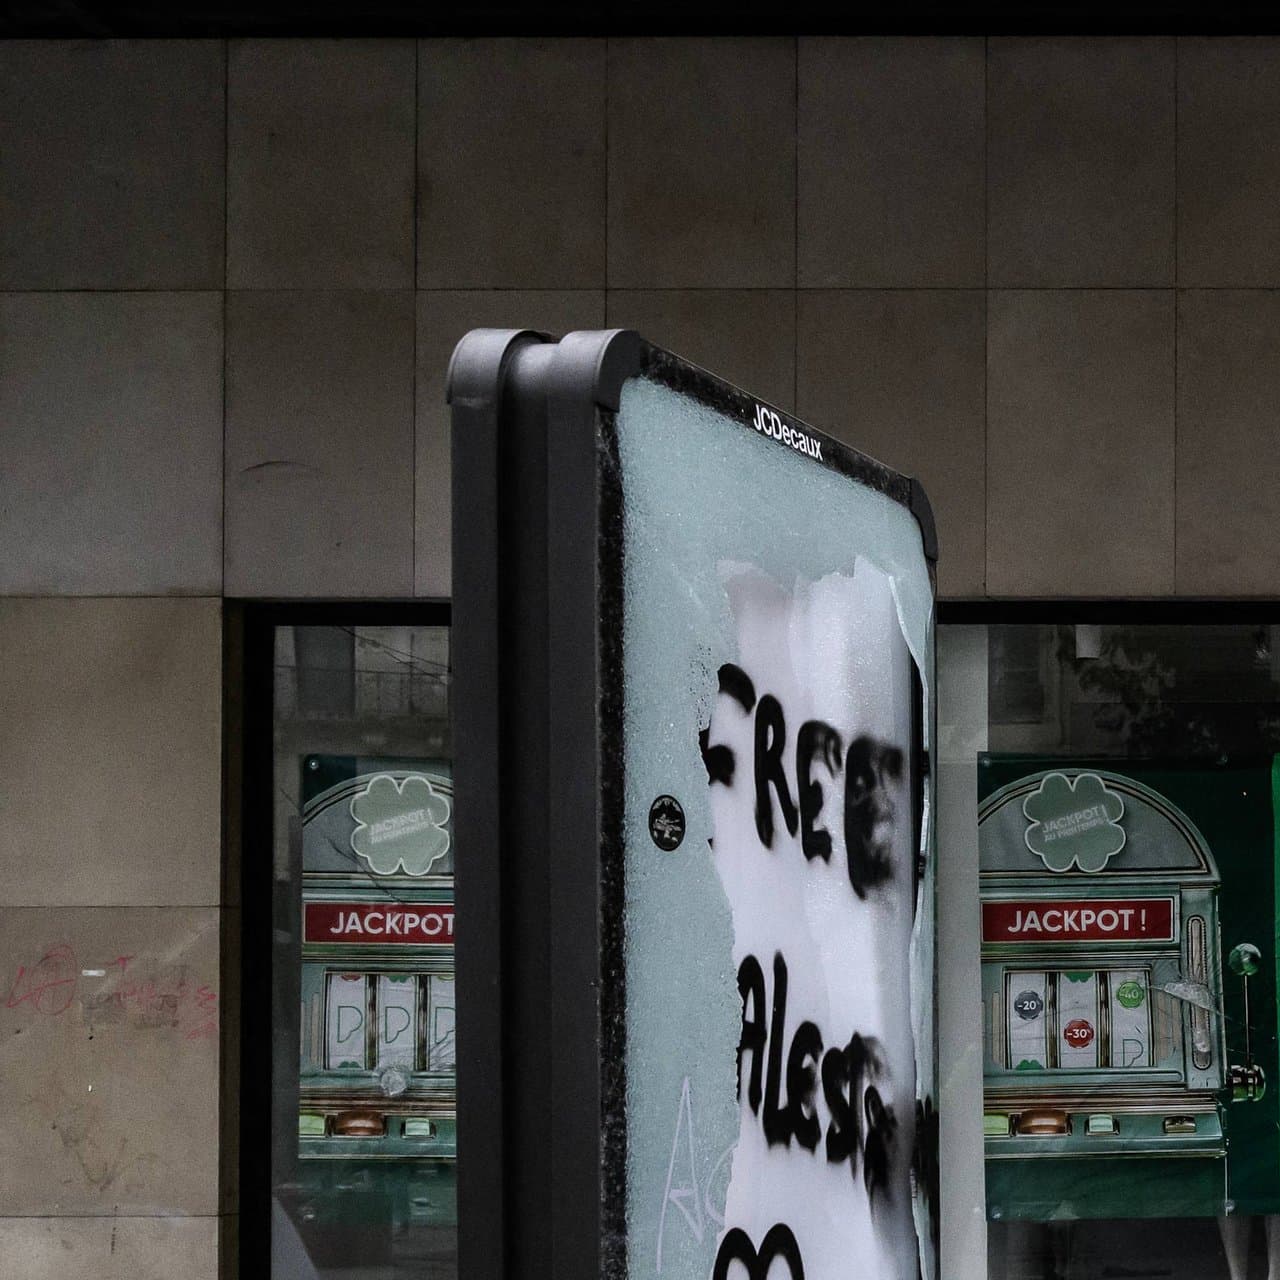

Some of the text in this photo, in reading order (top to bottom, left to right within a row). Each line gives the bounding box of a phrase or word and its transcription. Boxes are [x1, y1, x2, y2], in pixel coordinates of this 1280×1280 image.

[753, 404, 824, 461] JCDecaux
[1042, 806, 1099, 833] JACKPOT
[1007, 909, 1135, 933] JACKPOT
